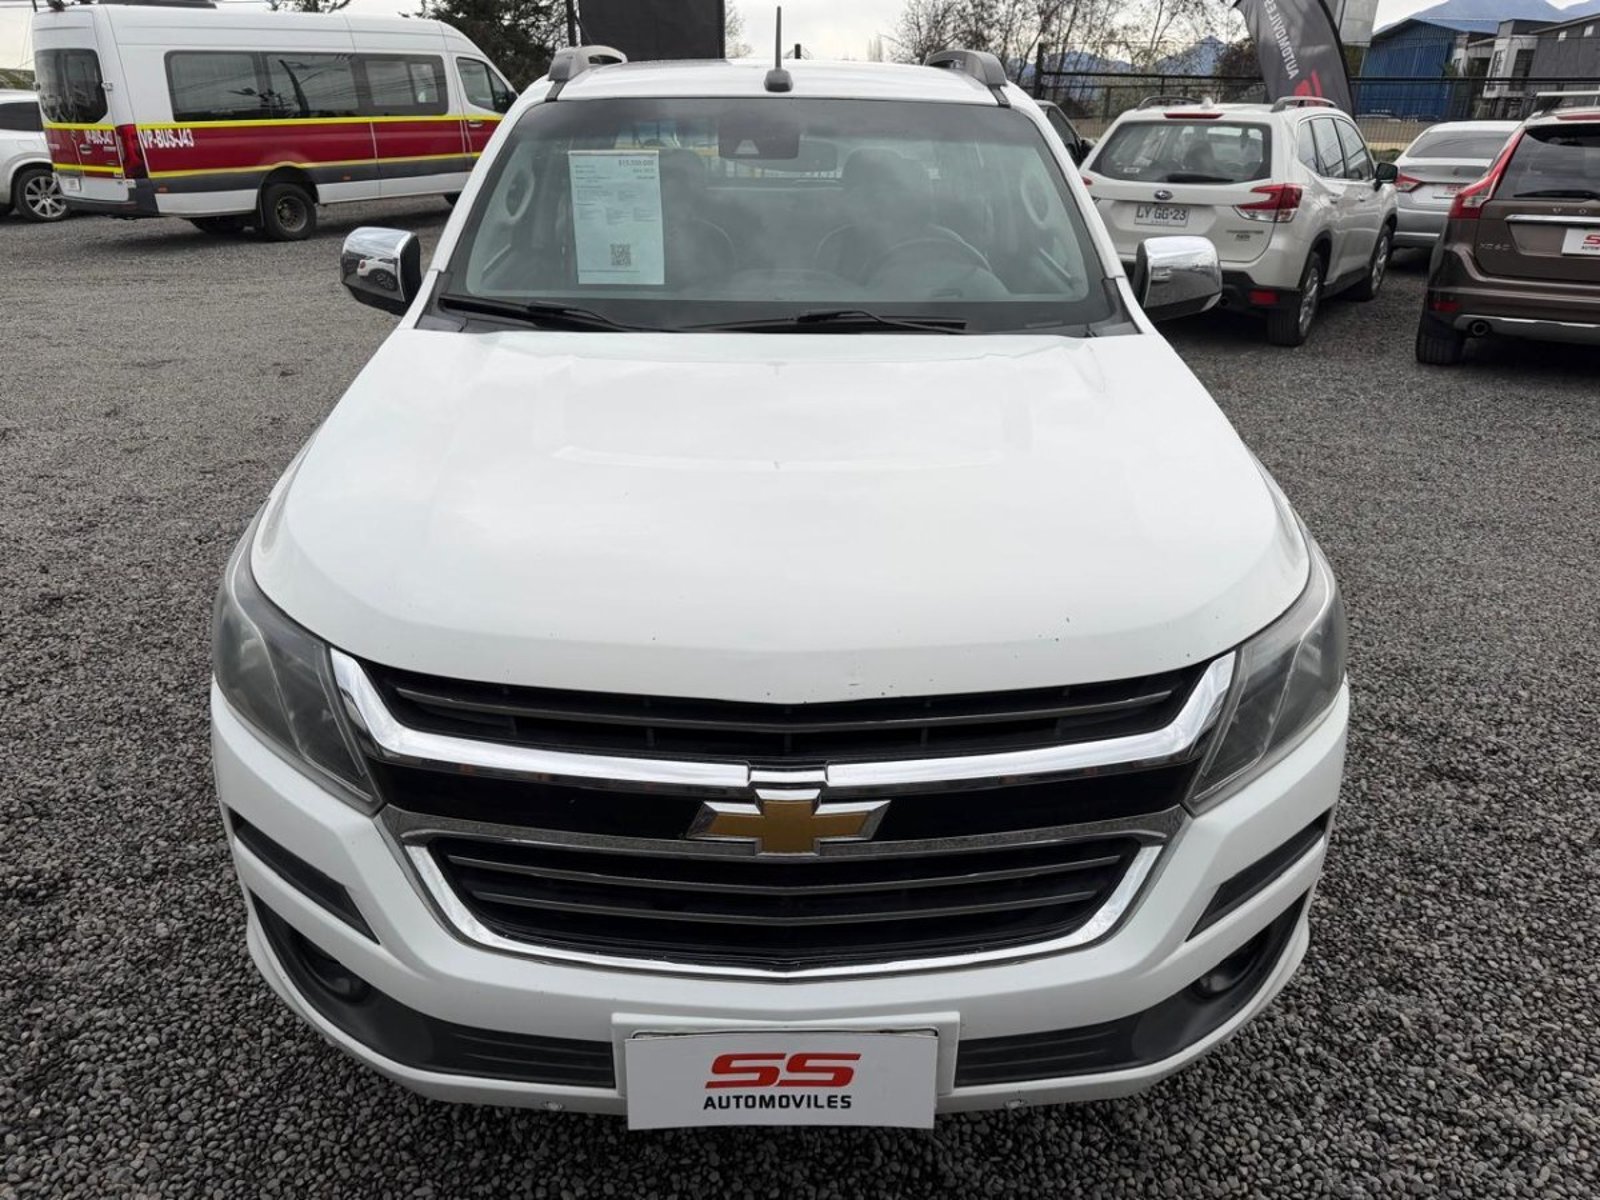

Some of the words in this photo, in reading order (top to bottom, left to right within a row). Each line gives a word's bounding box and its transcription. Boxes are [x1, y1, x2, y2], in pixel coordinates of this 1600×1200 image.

[138, 128, 195, 149] VP-BUS-J43
[705, 1053, 862, 1089] SS
[703, 1094, 852, 1111] AUTOMOVILES
